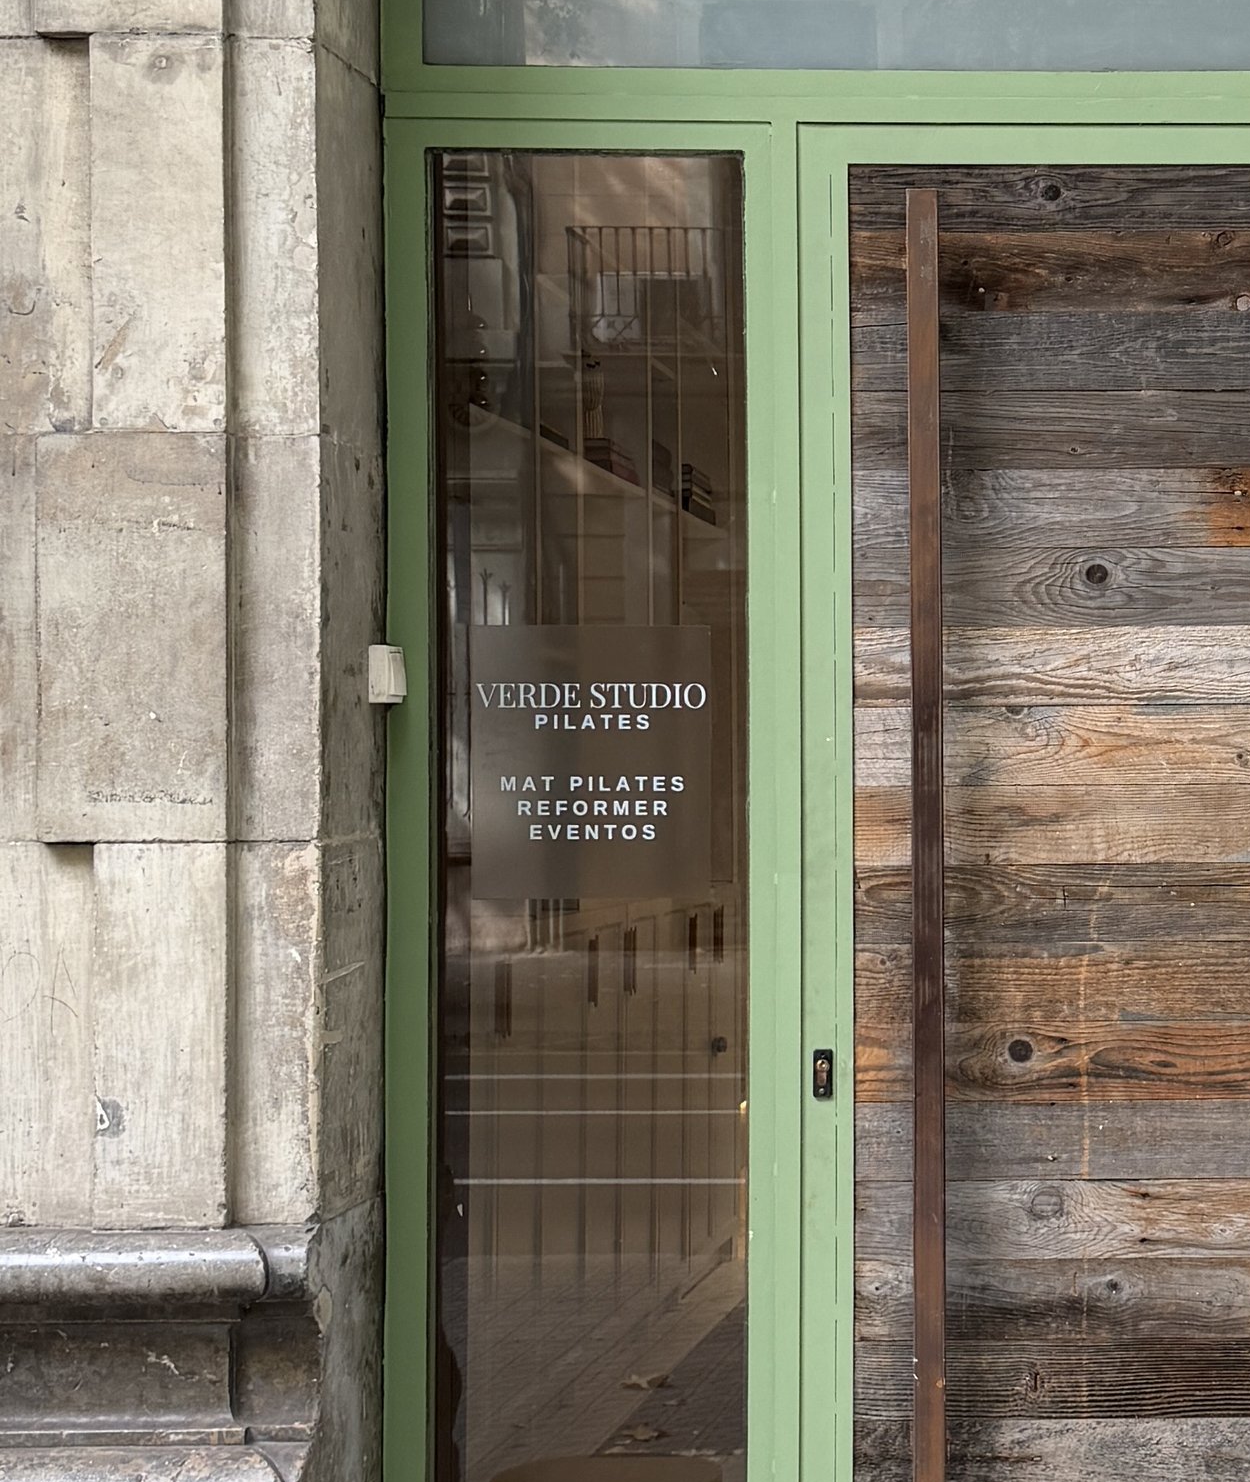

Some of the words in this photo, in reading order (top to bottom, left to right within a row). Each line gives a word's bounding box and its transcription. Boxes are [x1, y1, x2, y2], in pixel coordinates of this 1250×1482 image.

[475, 682, 581, 709] VERDE
[590, 682, 707, 709] STUDIO
[534, 714, 650, 730] PILATES
[500, 776, 555, 792] MAT
[569, 776, 685, 792] PILATES
[517, 800, 668, 816] REFORMER
[529, 824, 656, 840] EVENTOS
